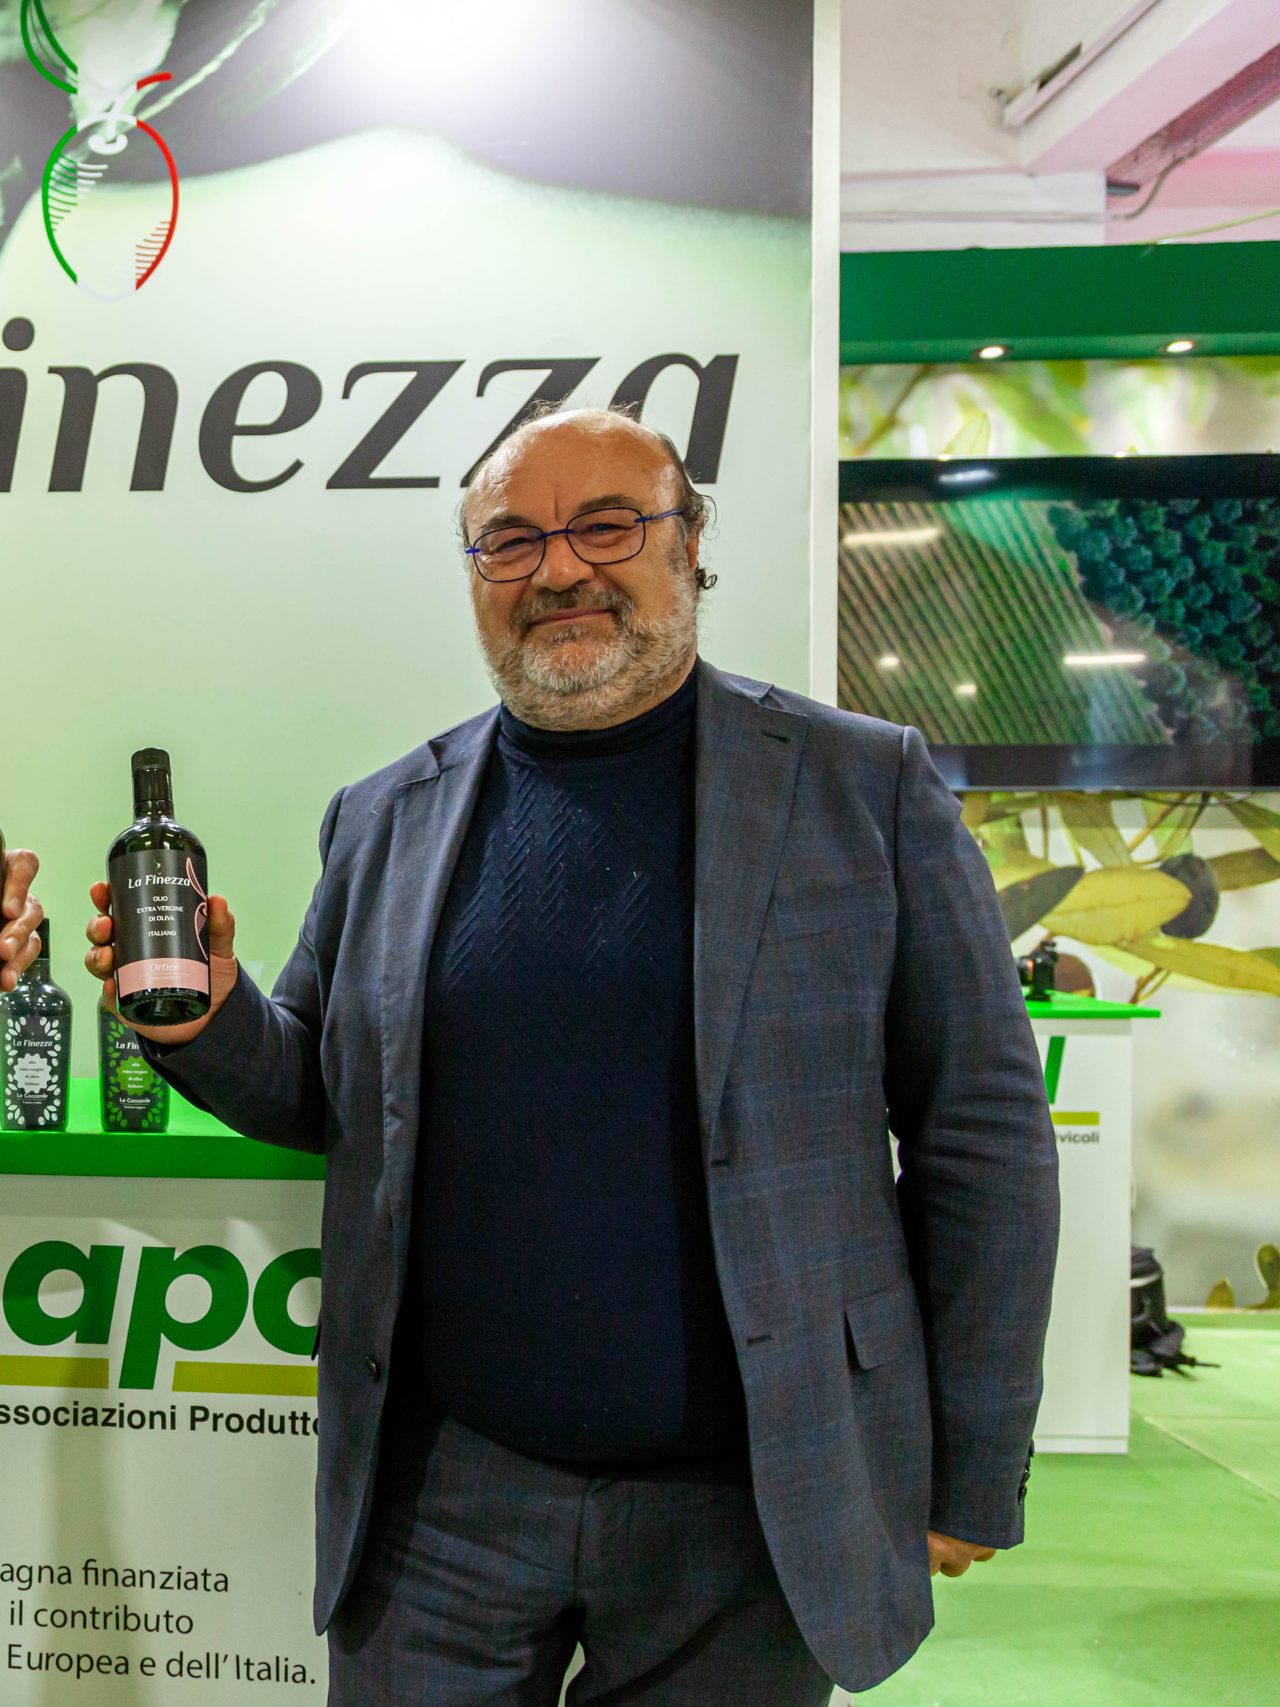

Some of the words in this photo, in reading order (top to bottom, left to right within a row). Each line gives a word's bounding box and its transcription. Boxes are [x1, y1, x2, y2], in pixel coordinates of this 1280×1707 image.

[128, 878, 142, 888] La
[145, 874, 191, 886] Finezza
[136, 906, 157, 914] EXTRA
[13, 1039, 22, 1047] La
[116, 1041, 126, 1049] La
[1057, 1130, 1100, 1144] vicoli
[189, 1405, 318, 1436] Produtt
[82, 1558, 229, 1592] finanziata
[10, 1599, 23, 1626] il
[33, 1604, 194, 1634] contributo
[8, 1643, 130, 1680] Europea
[139, 1656, 157, 1676] e
